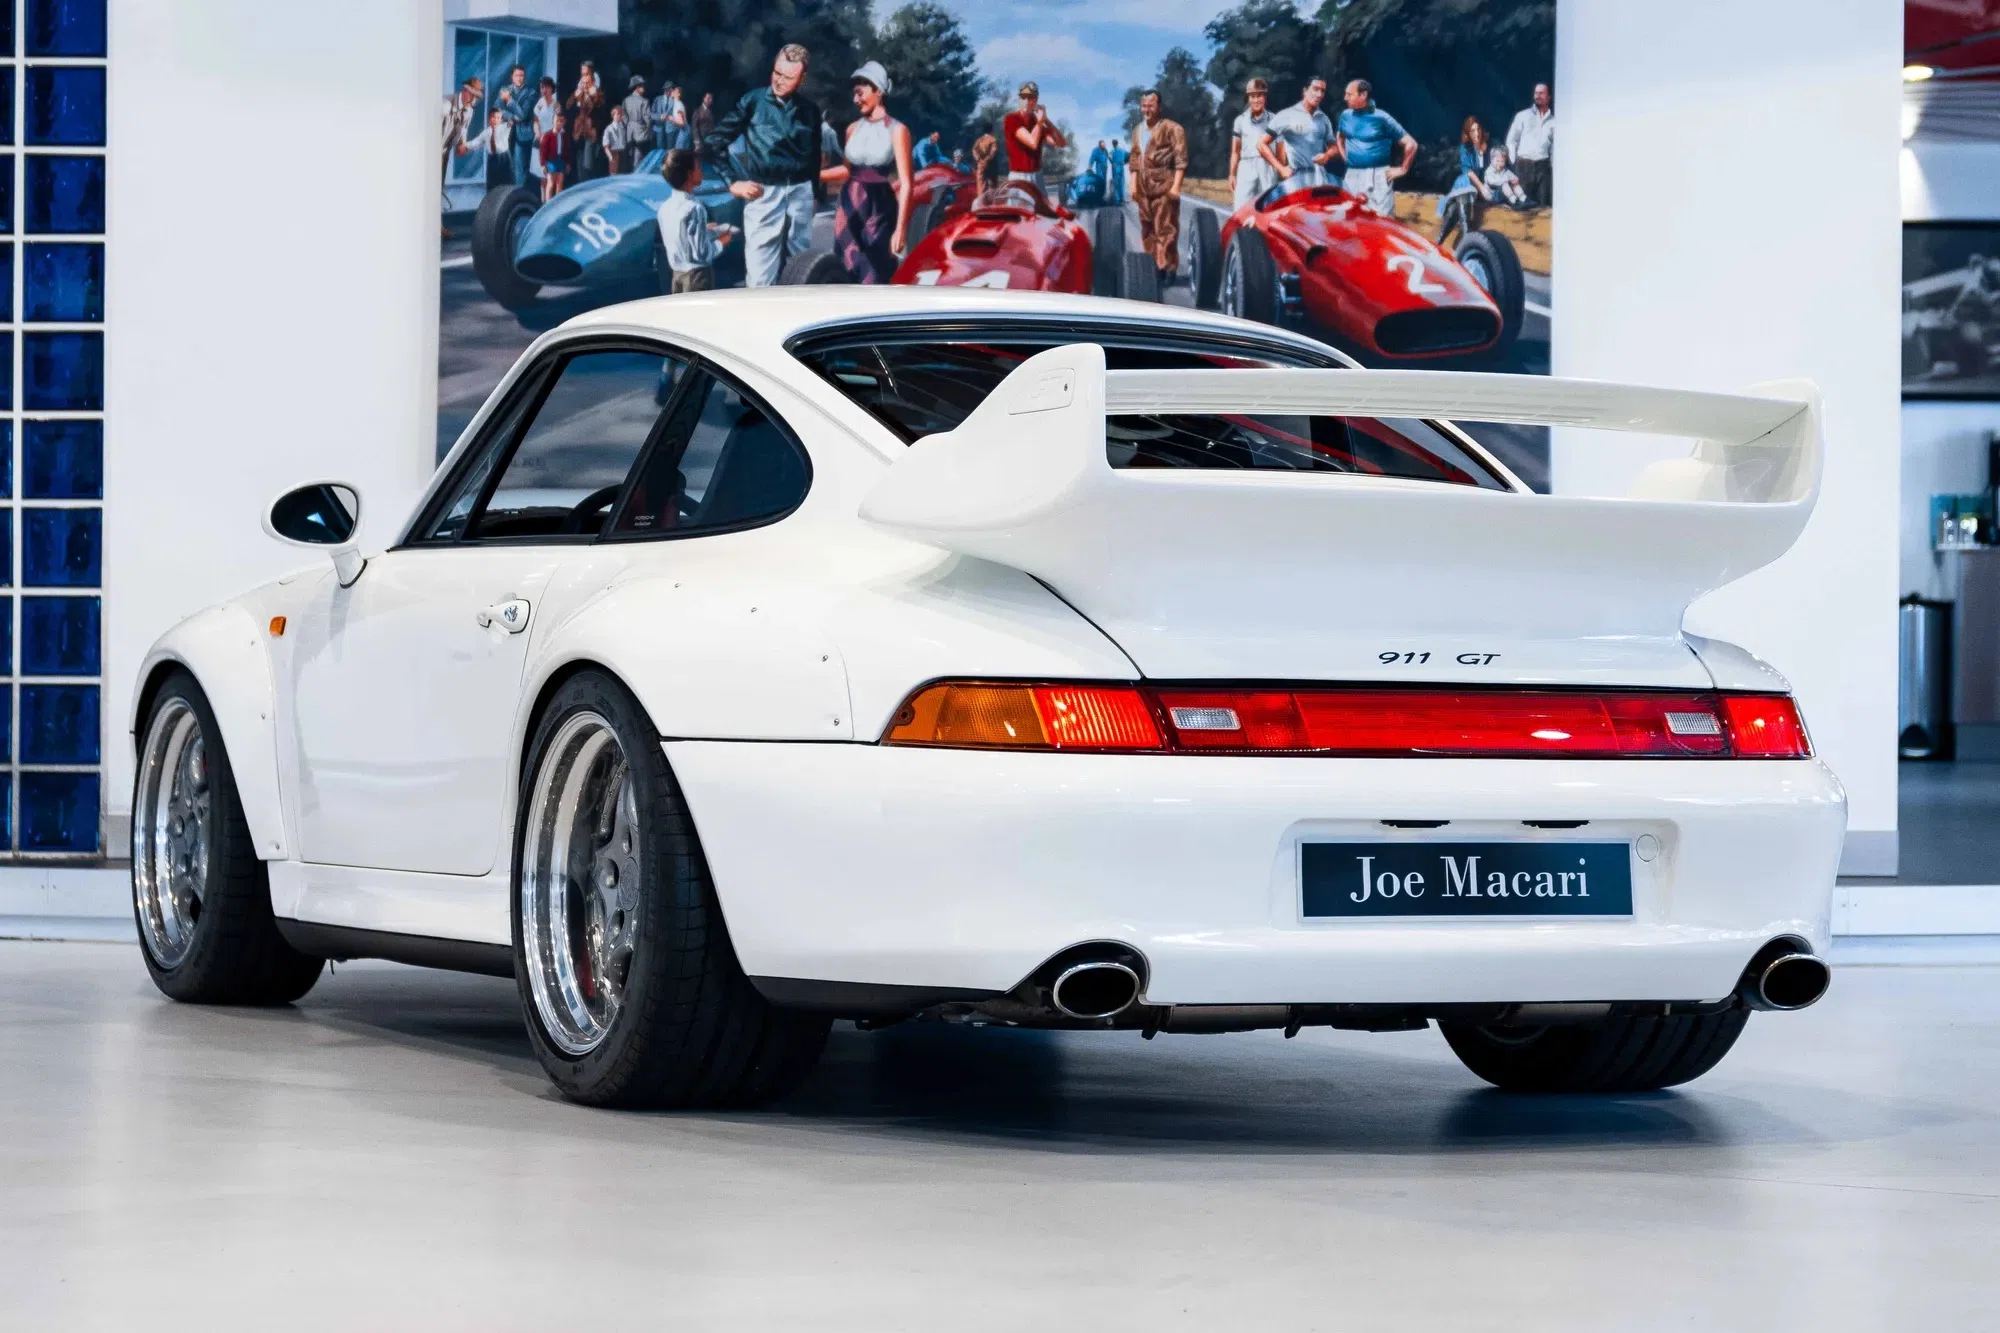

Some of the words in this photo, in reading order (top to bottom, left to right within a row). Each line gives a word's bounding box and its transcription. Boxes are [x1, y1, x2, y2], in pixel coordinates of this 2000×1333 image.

[568, 213, 621, 249] 18
[1387, 255, 1447, 295] 2
[1378, 651, 1431, 664] 911
[1456, 653, 1501, 665] GT
[1350, 856, 1425, 903] Joe
[1440, 856, 1590, 898] Macari
